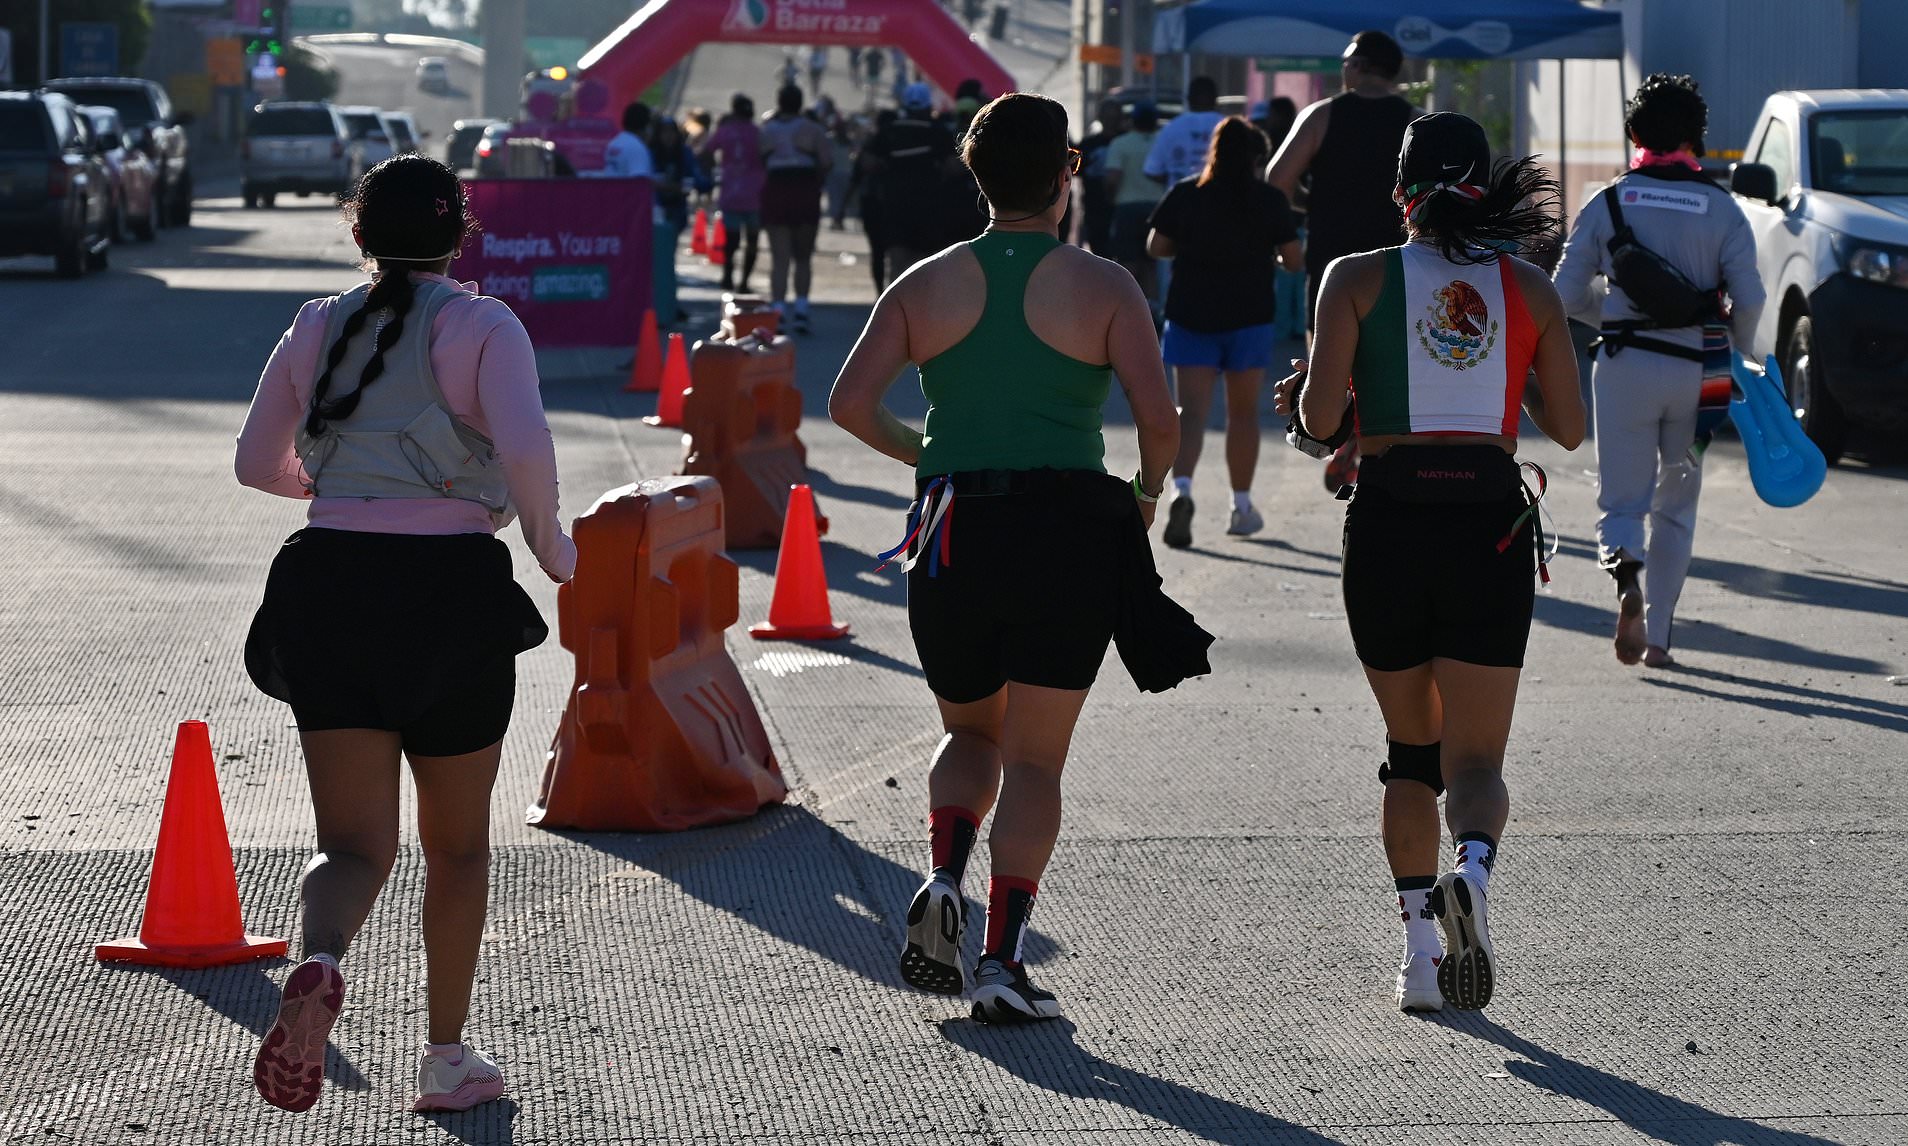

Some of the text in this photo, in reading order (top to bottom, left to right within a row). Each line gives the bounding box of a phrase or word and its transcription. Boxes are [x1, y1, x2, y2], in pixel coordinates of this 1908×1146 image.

[775, 8, 881, 33] Barraza
[1641, 193, 1701, 208] #BarefootElvis
[483, 231, 621, 262] Respira. You are
[483, 271, 529, 299] doing
[1417, 469, 1476, 480] NATHAN
